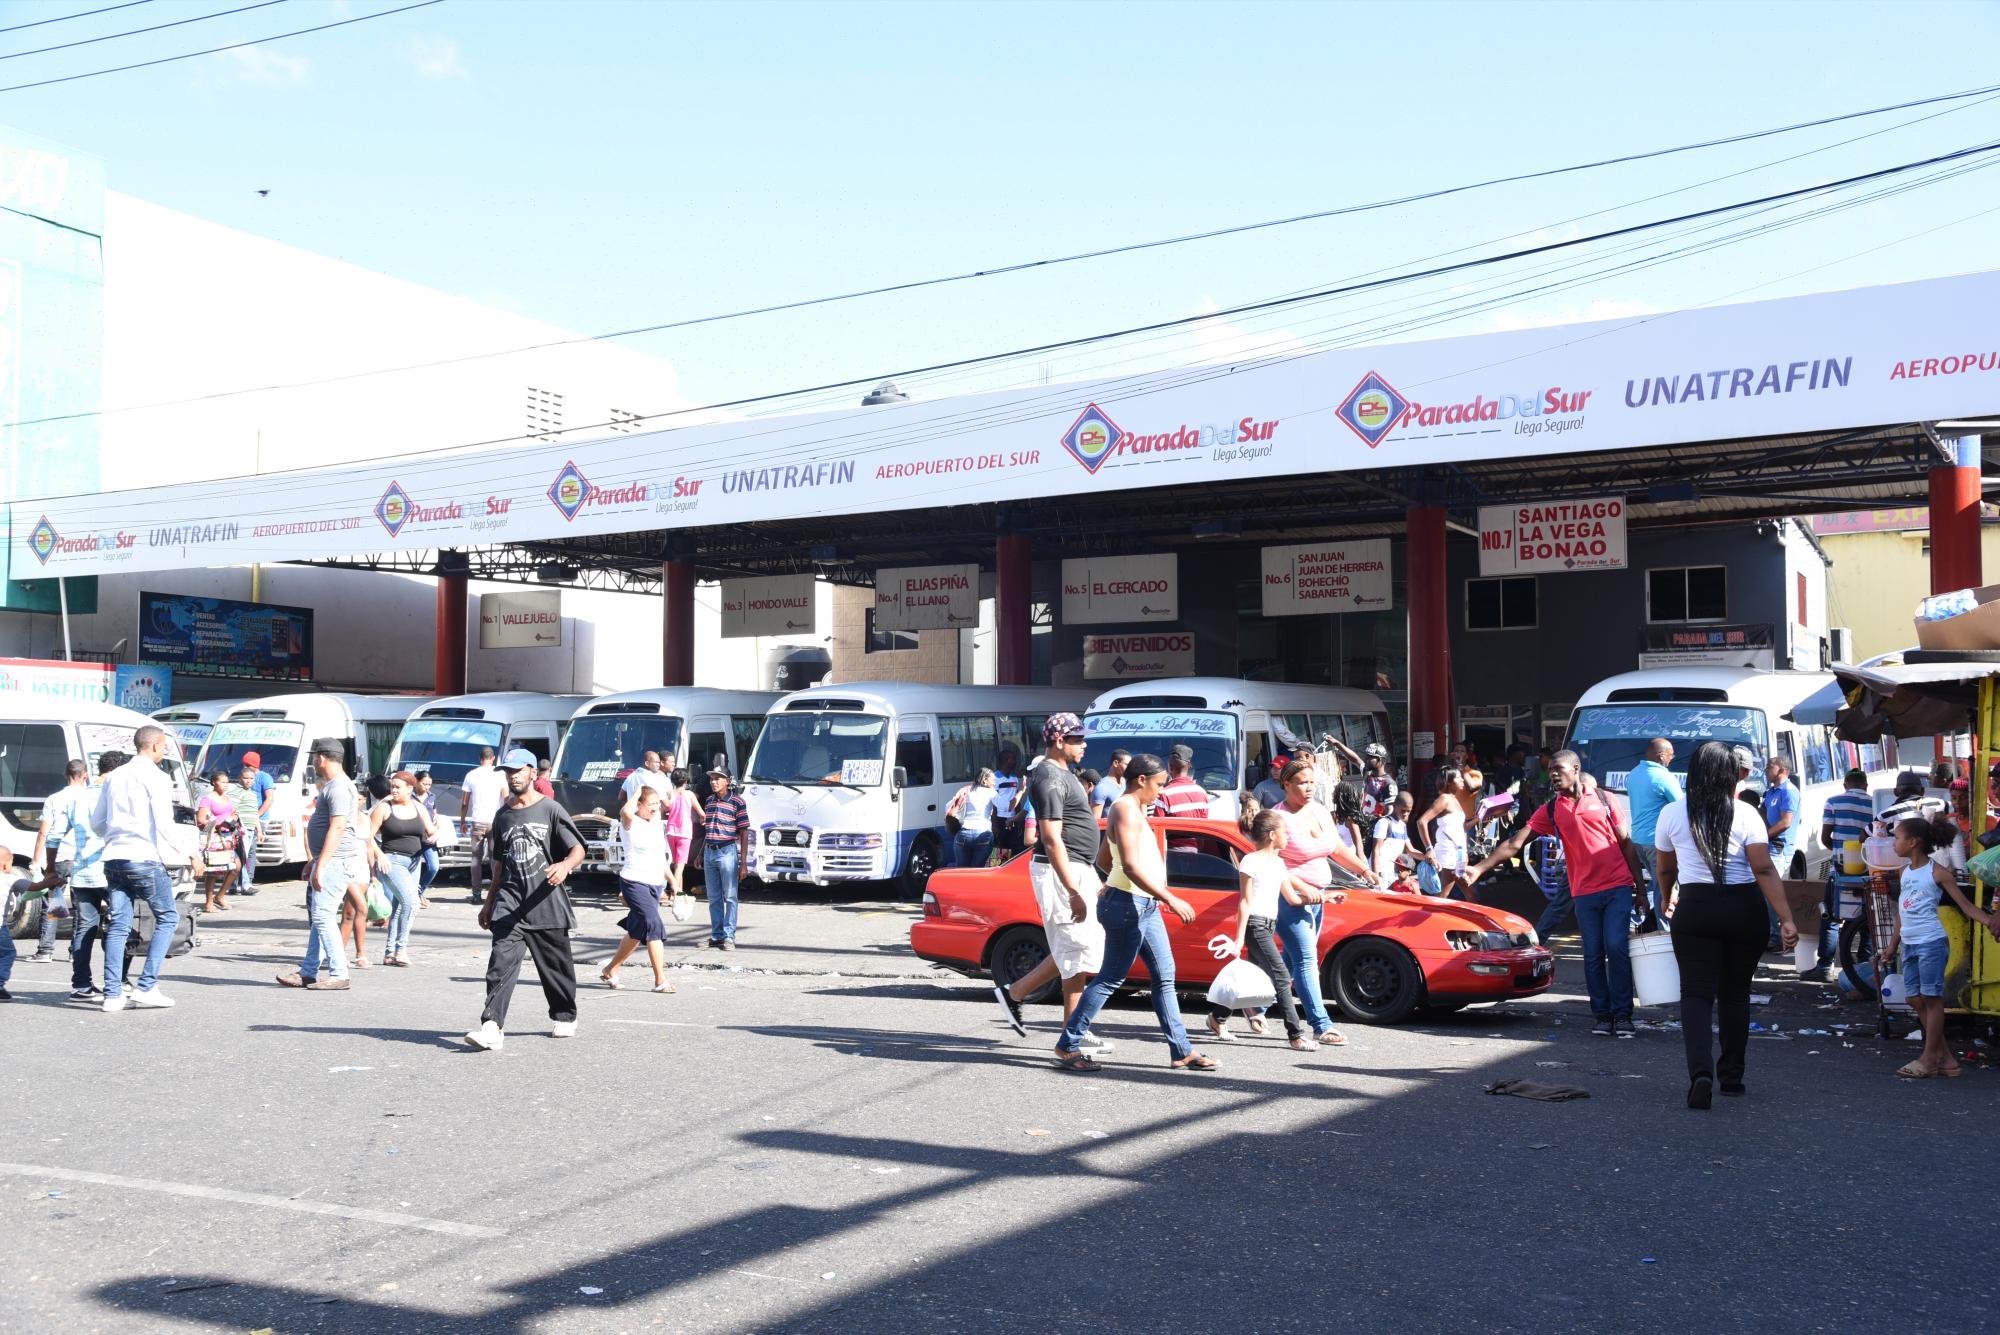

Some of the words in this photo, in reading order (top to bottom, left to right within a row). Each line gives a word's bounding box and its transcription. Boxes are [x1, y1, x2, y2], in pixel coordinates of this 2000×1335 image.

[1889, 351, 2000, 381] AEROPU
[1624, 356, 1853, 408] UNATRAFIN
[1514, 419, 1542, 437] Llega
[1544, 416, 1585, 436] Seguro!
[1213, 447, 1237, 464] Llega
[1238, 444, 1273, 462] Seguro!
[875, 456, 974, 479] AEROPUERTO
[977, 454, 1006, 470] DEL
[1009, 450, 1041, 466] SUR
[722, 460, 856, 494] UNATRAFIN
[655, 501, 673, 514] Llega
[674, 499, 699, 513] Seguro!
[1518, 501, 1622, 524] SANTIAGO
[1871, 506, 1930, 525] EXP
[149, 522, 239, 547] UNATRAFIN
[252, 521, 317, 538] AEROPUERTO
[319, 519, 337, 532] DEL
[341, 517, 361, 530] SUR
[1519, 526, 1543, 542] LA
[1550, 522, 1606, 540] VEGA
[1481, 530, 1512, 551] NO.7
[1298, 553, 1318, 564] SAN
[1319, 552, 1345, 562] JUAN
[1519, 540, 1607, 561] BONAO
[1298, 565, 1324, 576] JUAN
[1325, 564, 1338, 574] DE
[1339, 561, 1384, 573] HERRERA
[906, 578, 938, 591] ELIAS
[940, 574, 969, 589] PIÑA
[1265, 574, 1282, 584] No.
[1283, 573, 1291, 583] 6
[1298, 575, 1350, 588] BOHECHÍO
[1064, 585, 1080, 594] No.
[1081, 585, 1087, 594] 5
[1093, 583, 1107, 595] EL
[1108, 580, 1168, 594] CERCADO
[1298, 588, 1350, 600] SABANETA
[724, 602, 736, 611] No.
[738, 602, 742, 610] 3
[748, 600, 781, 610] HONDO
[782, 597, 808, 608] VALLE
[878, 593, 892, 602] No.
[893, 593, 898, 602] 4
[906, 596, 917, 606] EL
[918, 595, 950, 606] LLANO
[502, 612, 557, 625] VALLEJUELO
[1088, 636, 1191, 654] BIENVENIDOS
[1672, 632, 1707, 645] PARADA
[120, 691, 162, 709] Loteka
[182, 728, 208, 739] Valle
[1190, 719, 1226, 732] Valle
[844, 761, 881, 769] EXPRESO
